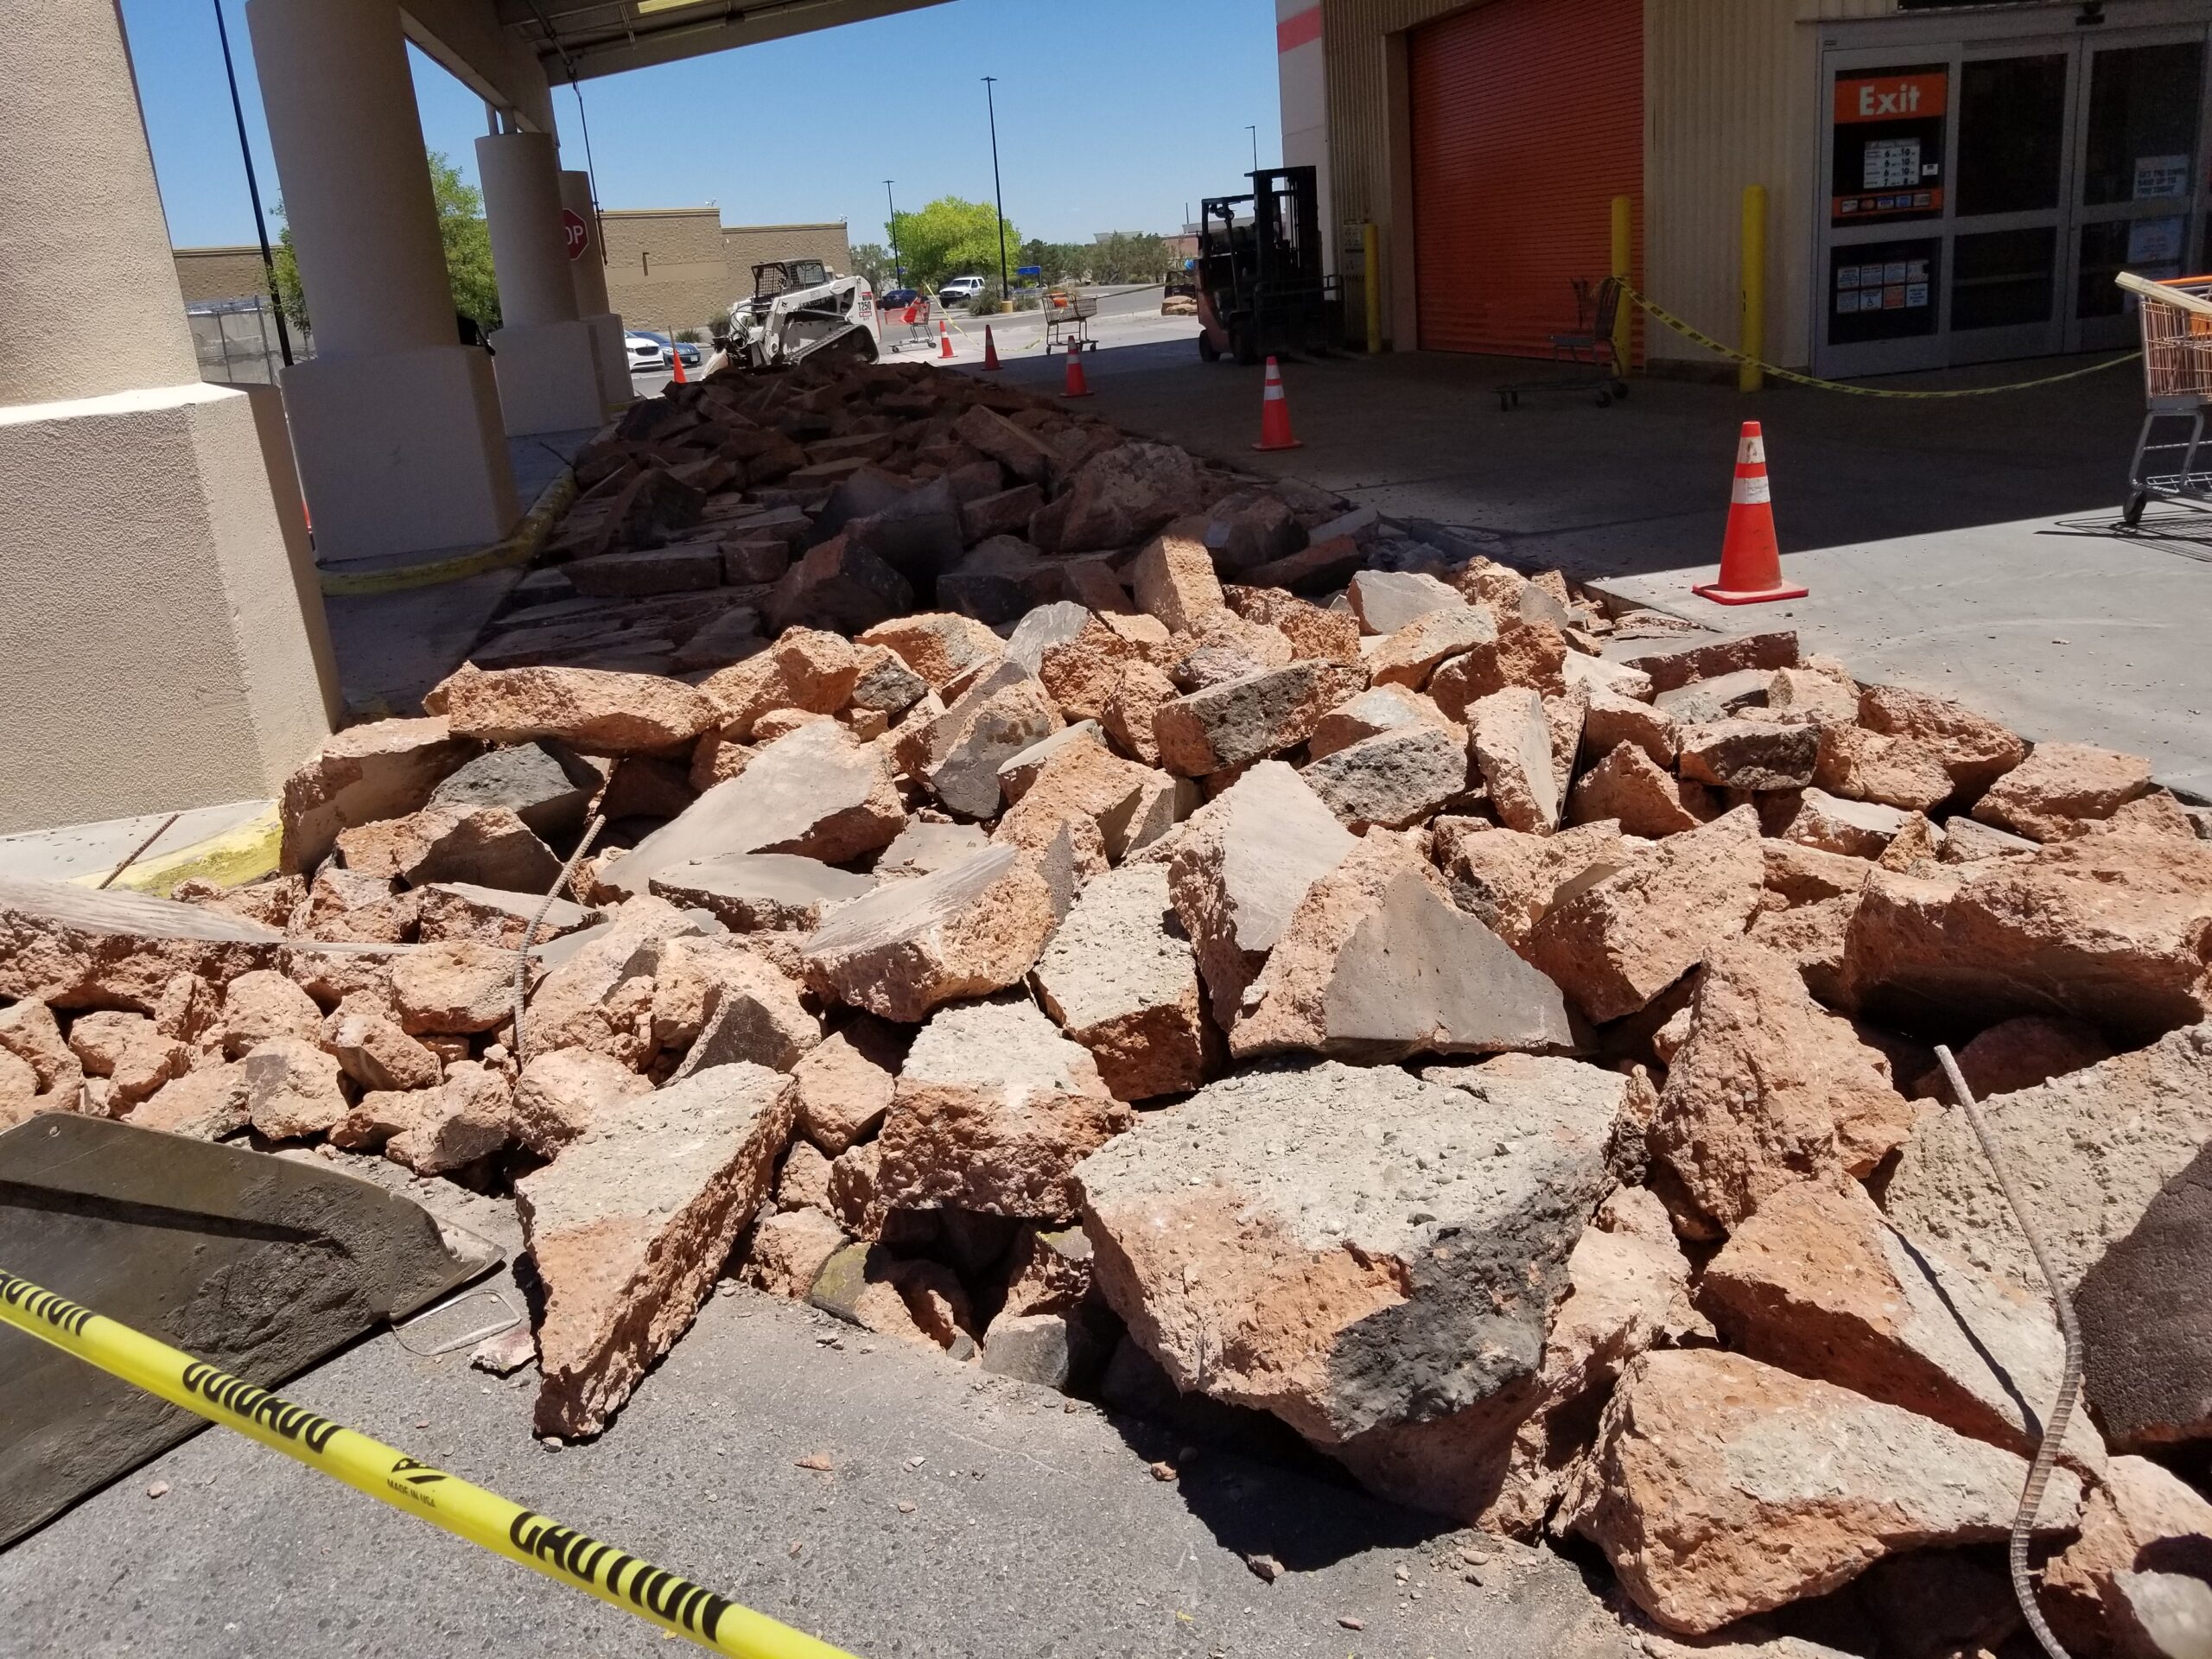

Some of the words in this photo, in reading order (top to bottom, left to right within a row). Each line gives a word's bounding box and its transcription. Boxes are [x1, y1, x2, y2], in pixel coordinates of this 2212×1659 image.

[1859, 83, 1921, 117] Exit
[565, 226, 583, 245] OP
[858, 301, 872, 312] T250
[387, 1478, 409, 1495] MADE
[410, 1488, 419, 1500] IN
[420, 1493, 435, 1508] USA
[510, 1511, 733, 1643] CAUTION
